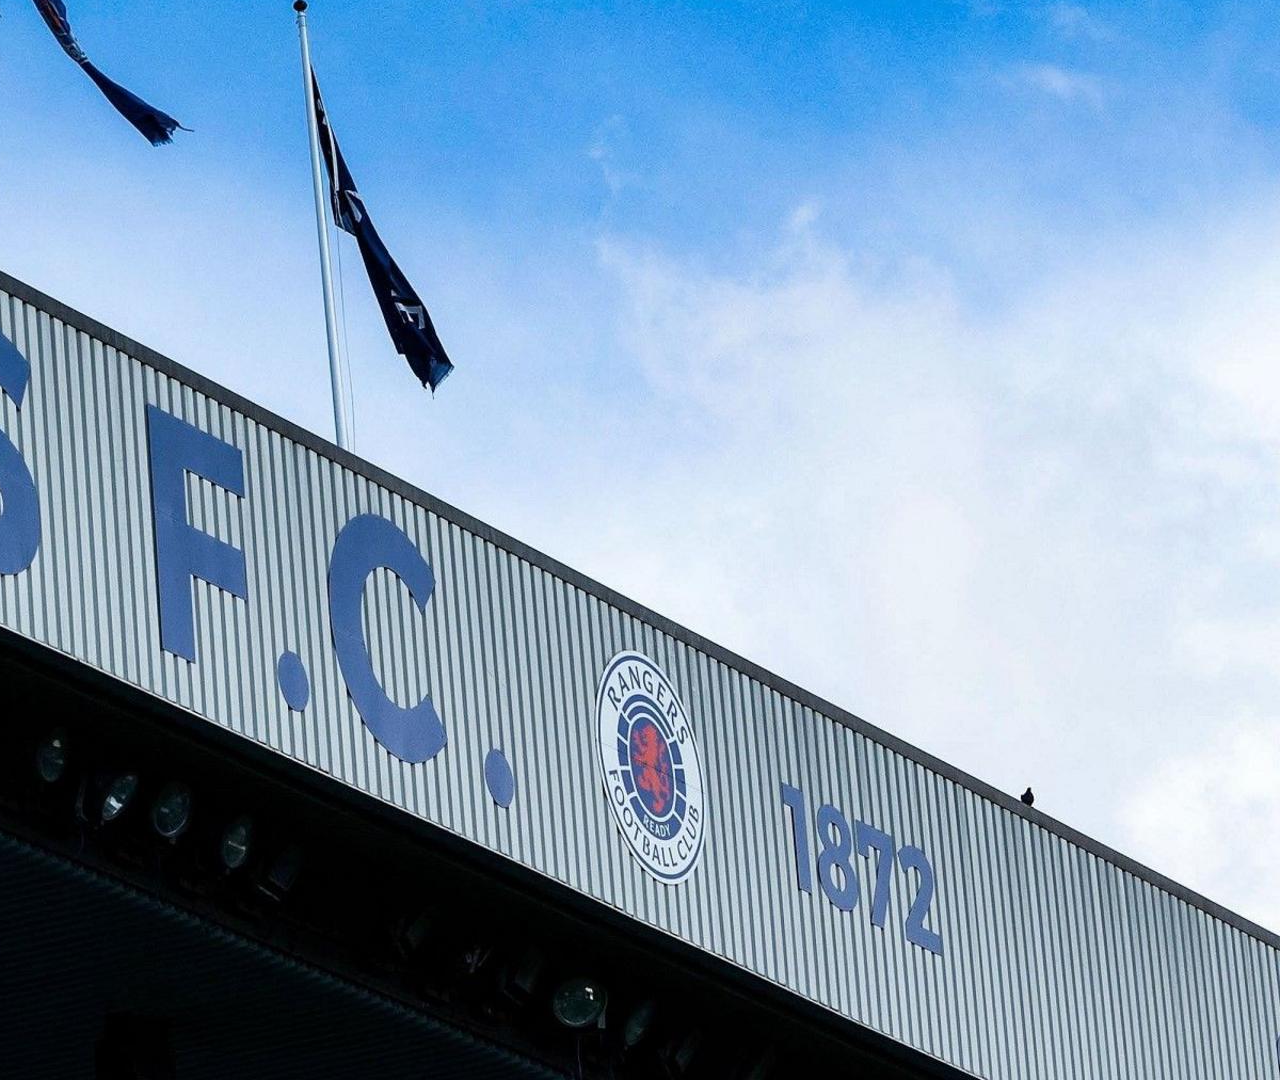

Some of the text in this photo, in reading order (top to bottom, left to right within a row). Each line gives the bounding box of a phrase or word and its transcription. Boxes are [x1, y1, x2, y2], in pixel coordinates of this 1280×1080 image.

[146, 403, 515, 809] F.C.
[607, 665, 689, 746] RANGERS
[608, 769, 700, 868] FOOTBALL CLUB
[642, 813, 672, 838] READY
[780, 782, 945, 957] 1872
